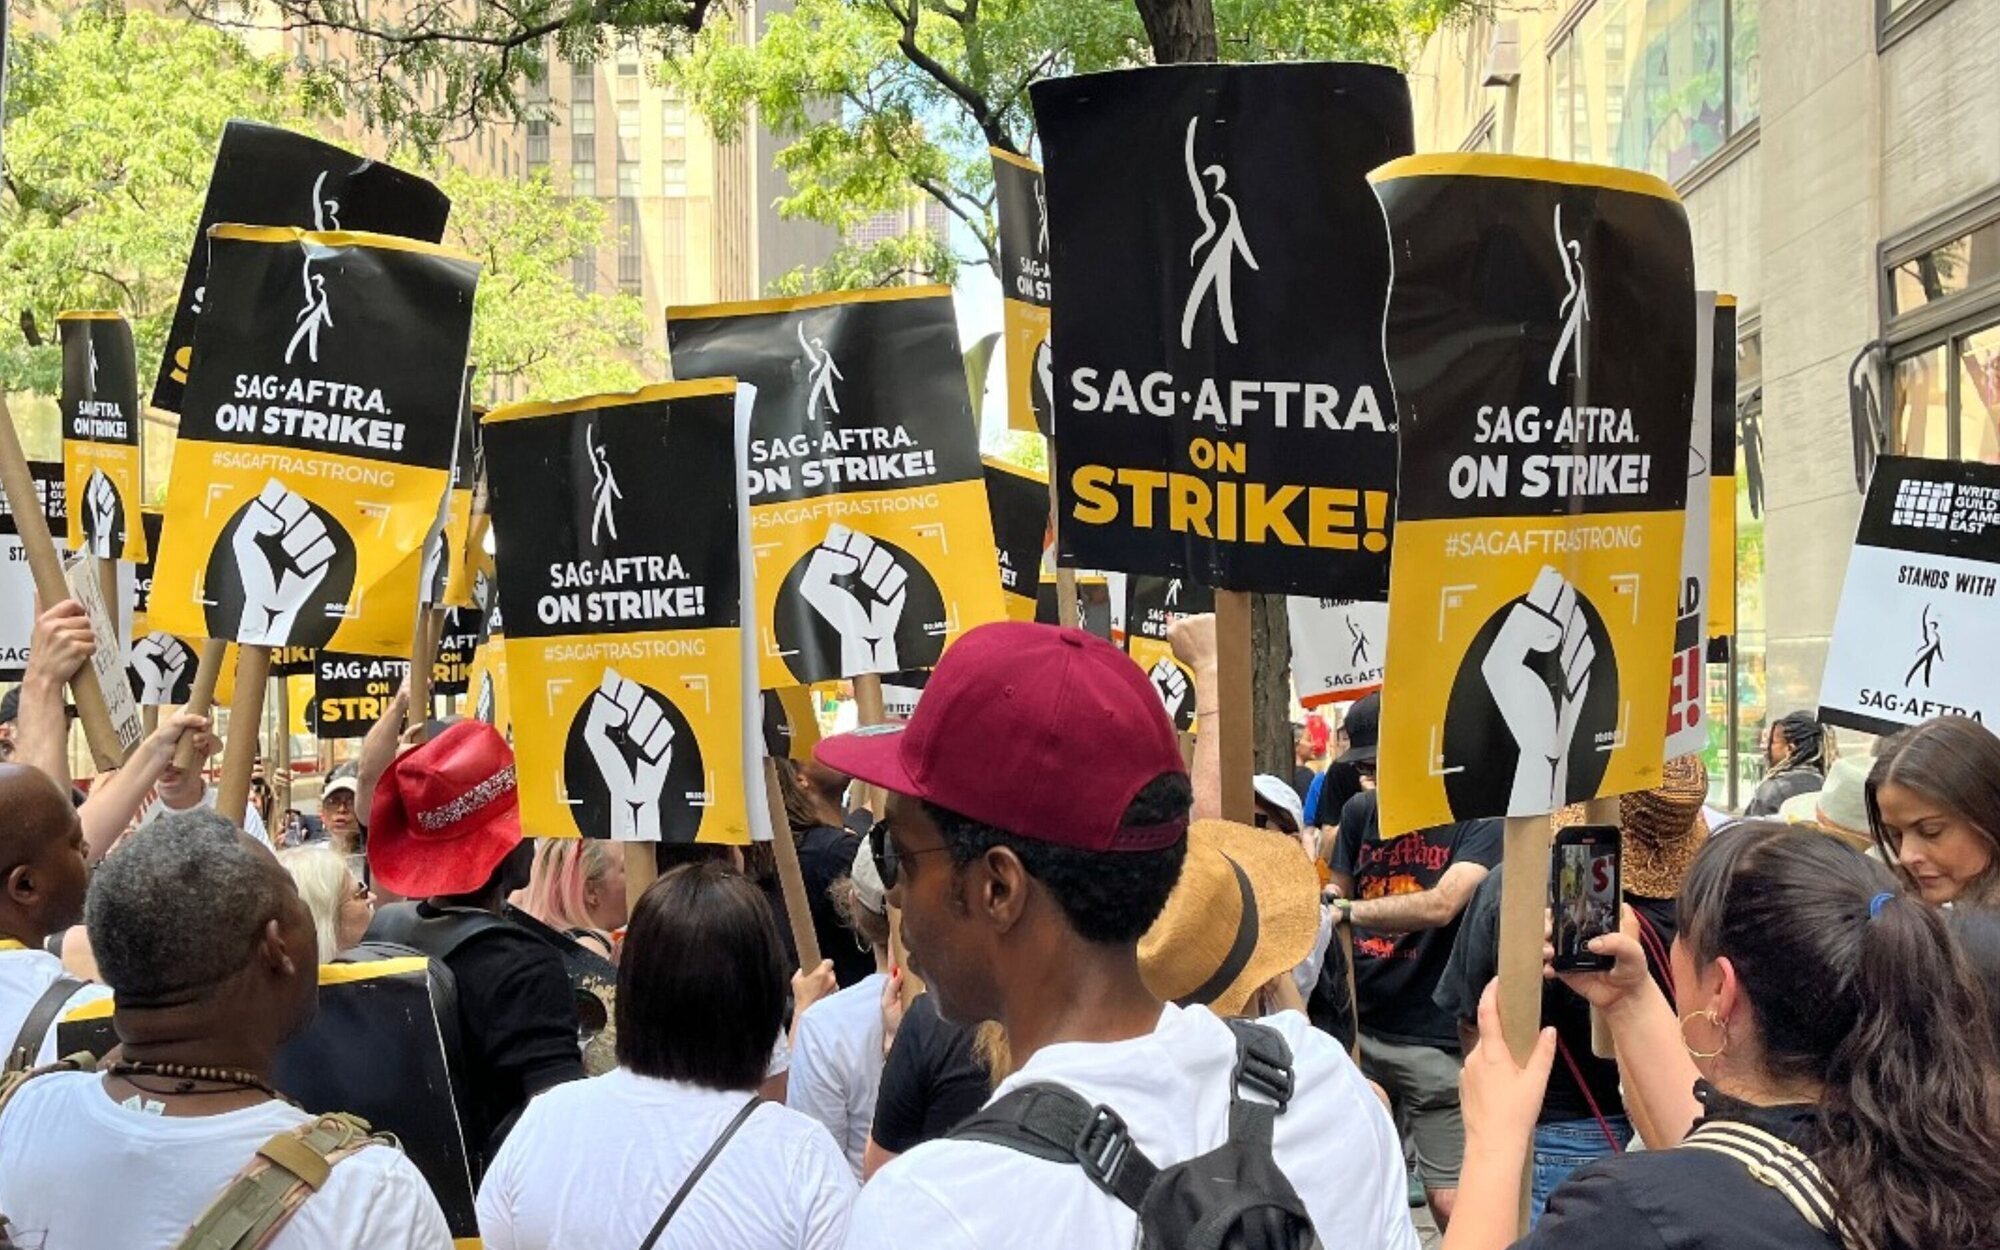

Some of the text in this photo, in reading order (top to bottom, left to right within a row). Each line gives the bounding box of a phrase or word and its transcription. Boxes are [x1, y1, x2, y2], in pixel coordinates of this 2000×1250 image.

[73, 417, 90, 435] ON
[216, 403, 406, 451] ON STRIKE!
[212, 451, 395, 488] #SAGAFTRASTRONG
[1189, 437, 1247, 474] ON
[747, 449, 937, 497] ON STRIKE!
[1449, 454, 1651, 499] ON STRIKE!
[751, 493, 939, 530] #SAGAFTRASTRONG
[1071, 464, 1389, 553] STRIKE!
[1952, 509, 1967, 519] of
[1955, 496, 1997, 511] GUILD
[1445, 525, 1643, 557] #SAGAFTRASTRONG
[1949, 520, 1985, 534] EAST
[1898, 565, 1997, 597] STANDS WITH
[538, 591, 581, 625] ON
[587, 586, 705, 623] STRIKE!
[440, 652, 462, 663] ON
[544, 638, 706, 663] #SAGAFTRASTRONG
[366, 682, 389, 695] ON
